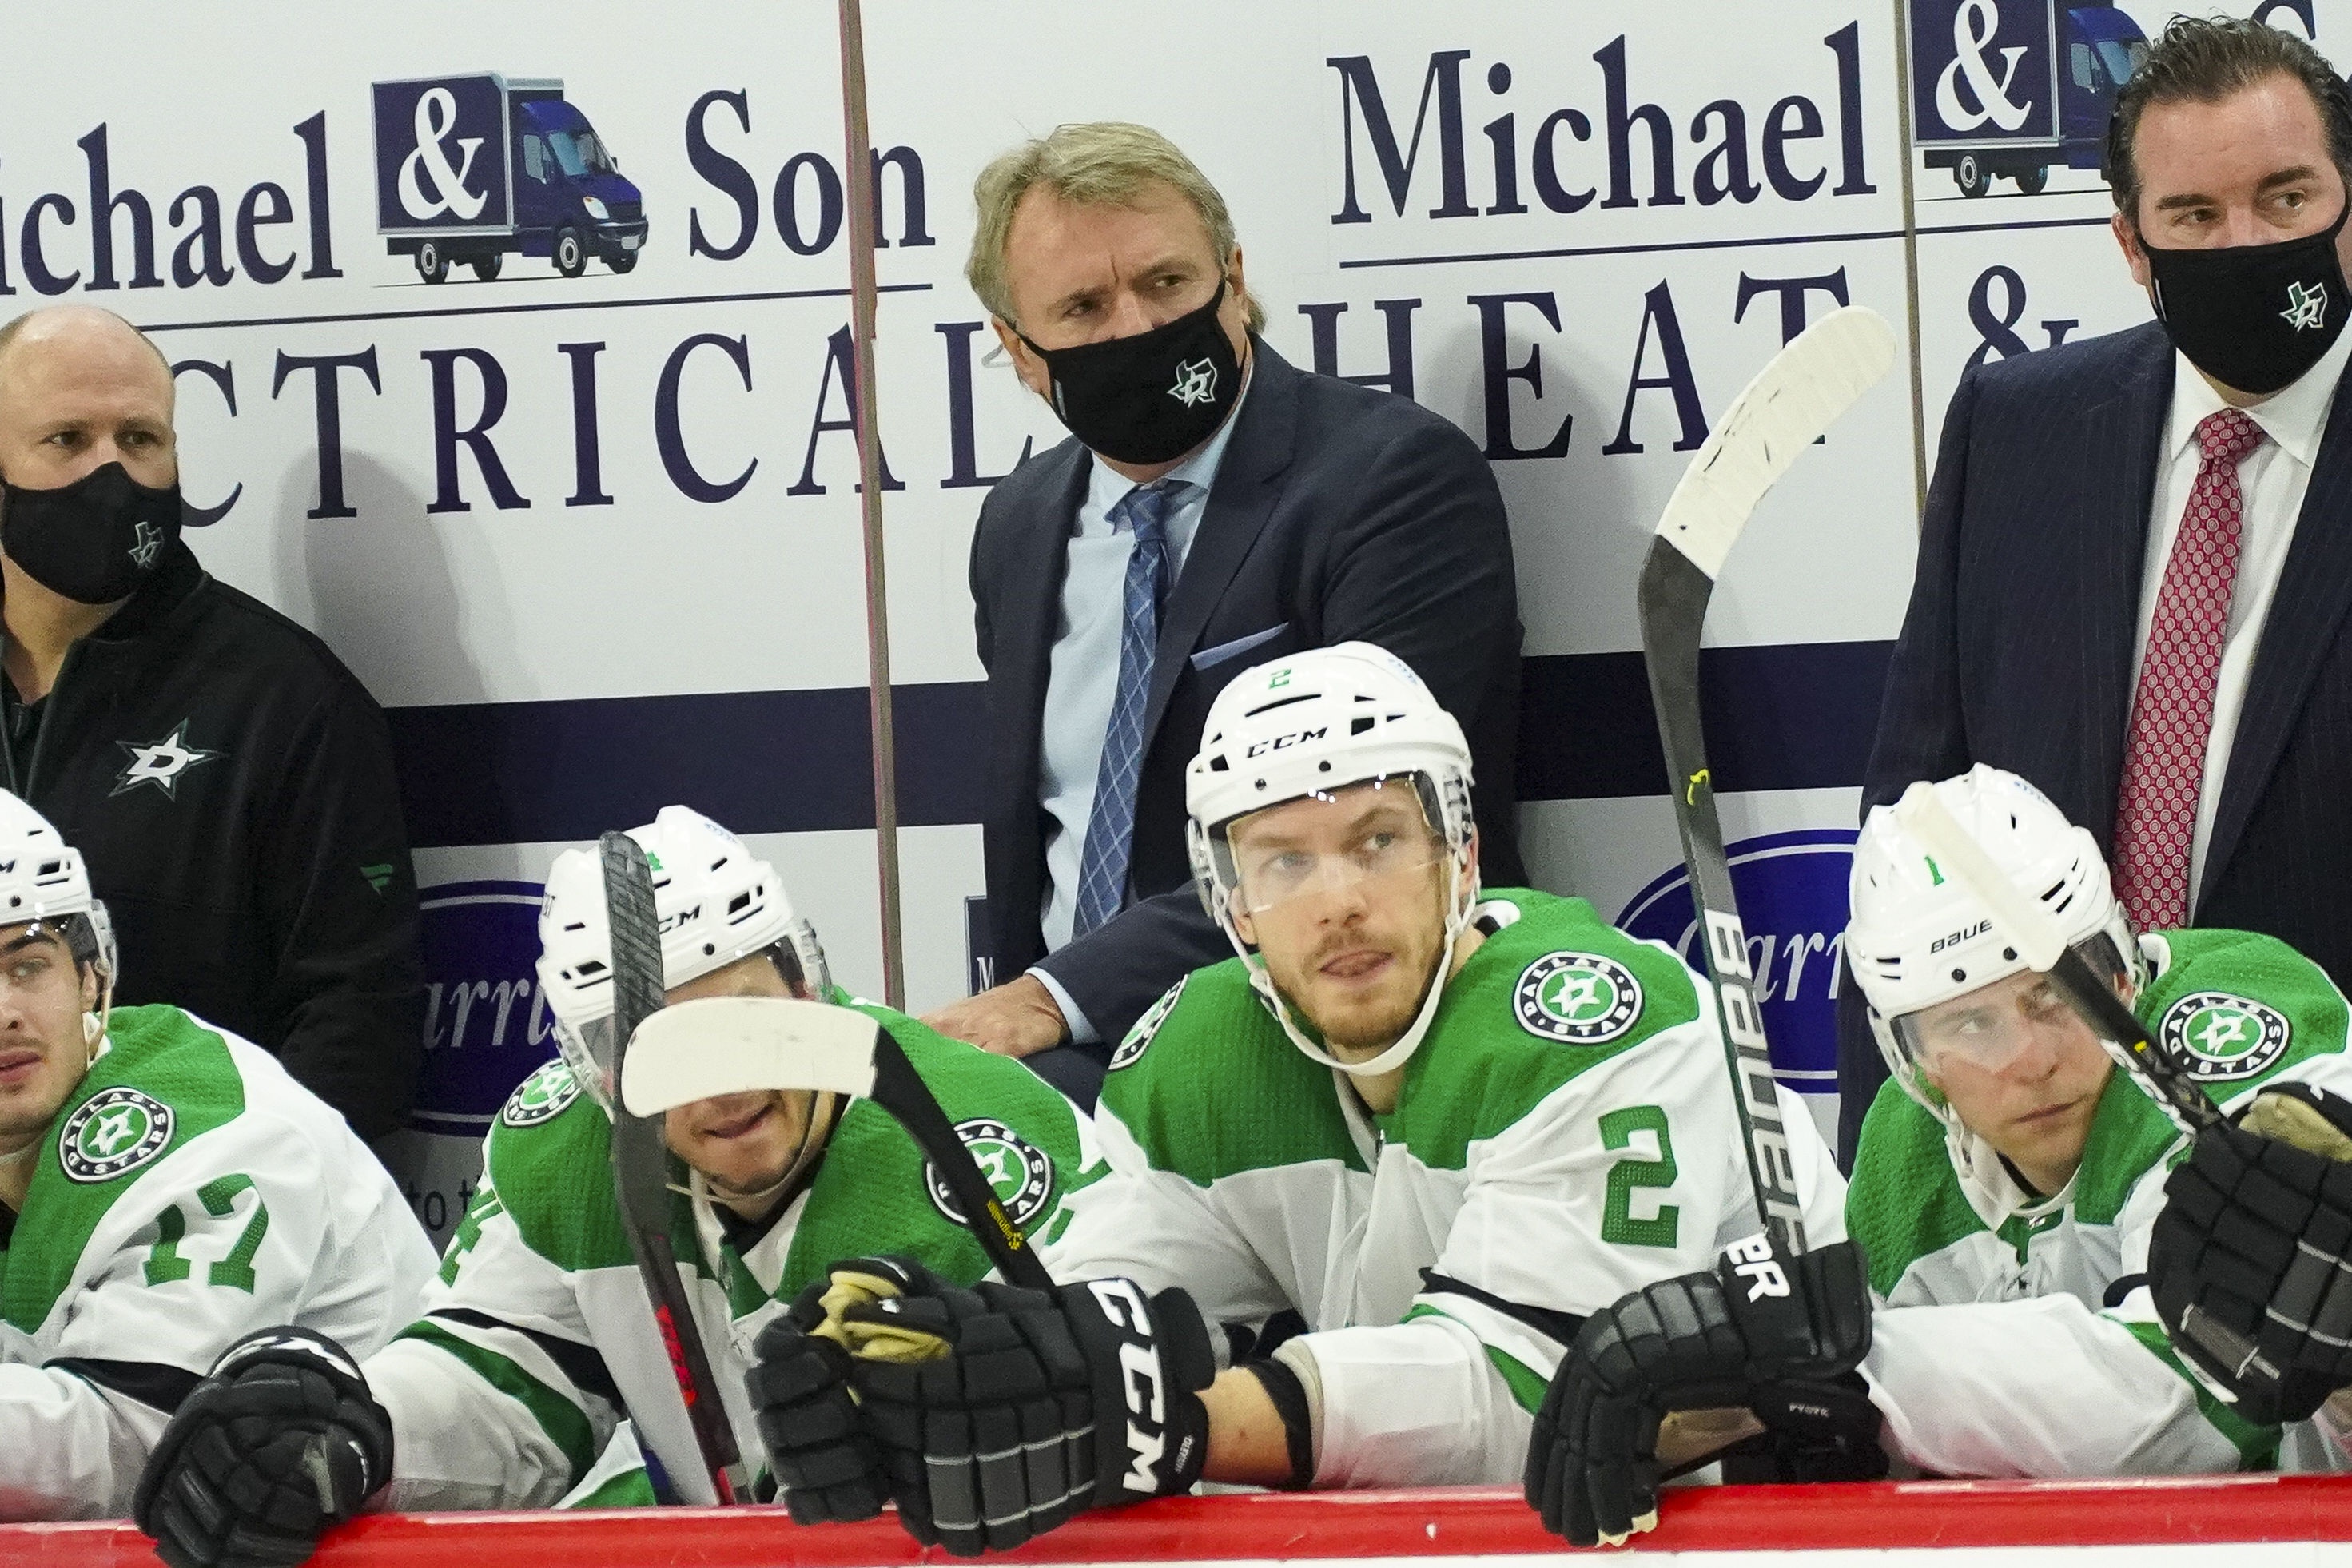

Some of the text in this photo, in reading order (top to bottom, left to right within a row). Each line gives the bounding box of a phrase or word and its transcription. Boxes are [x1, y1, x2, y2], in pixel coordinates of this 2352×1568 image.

[398, 87, 488, 221] &
[684, 87, 936, 261] Son
[1325, 0, 2032, 225] Michael &
[169, 321, 1033, 527] CTRICAL
[1247, 726, 1328, 758] CCM
[1269, 668, 1291, 689] 2
[1930, 918, 1993, 955] BAUE
[1598, 1104, 1679, 1248] 2
[1087, 1277, 1165, 1494] CCM
